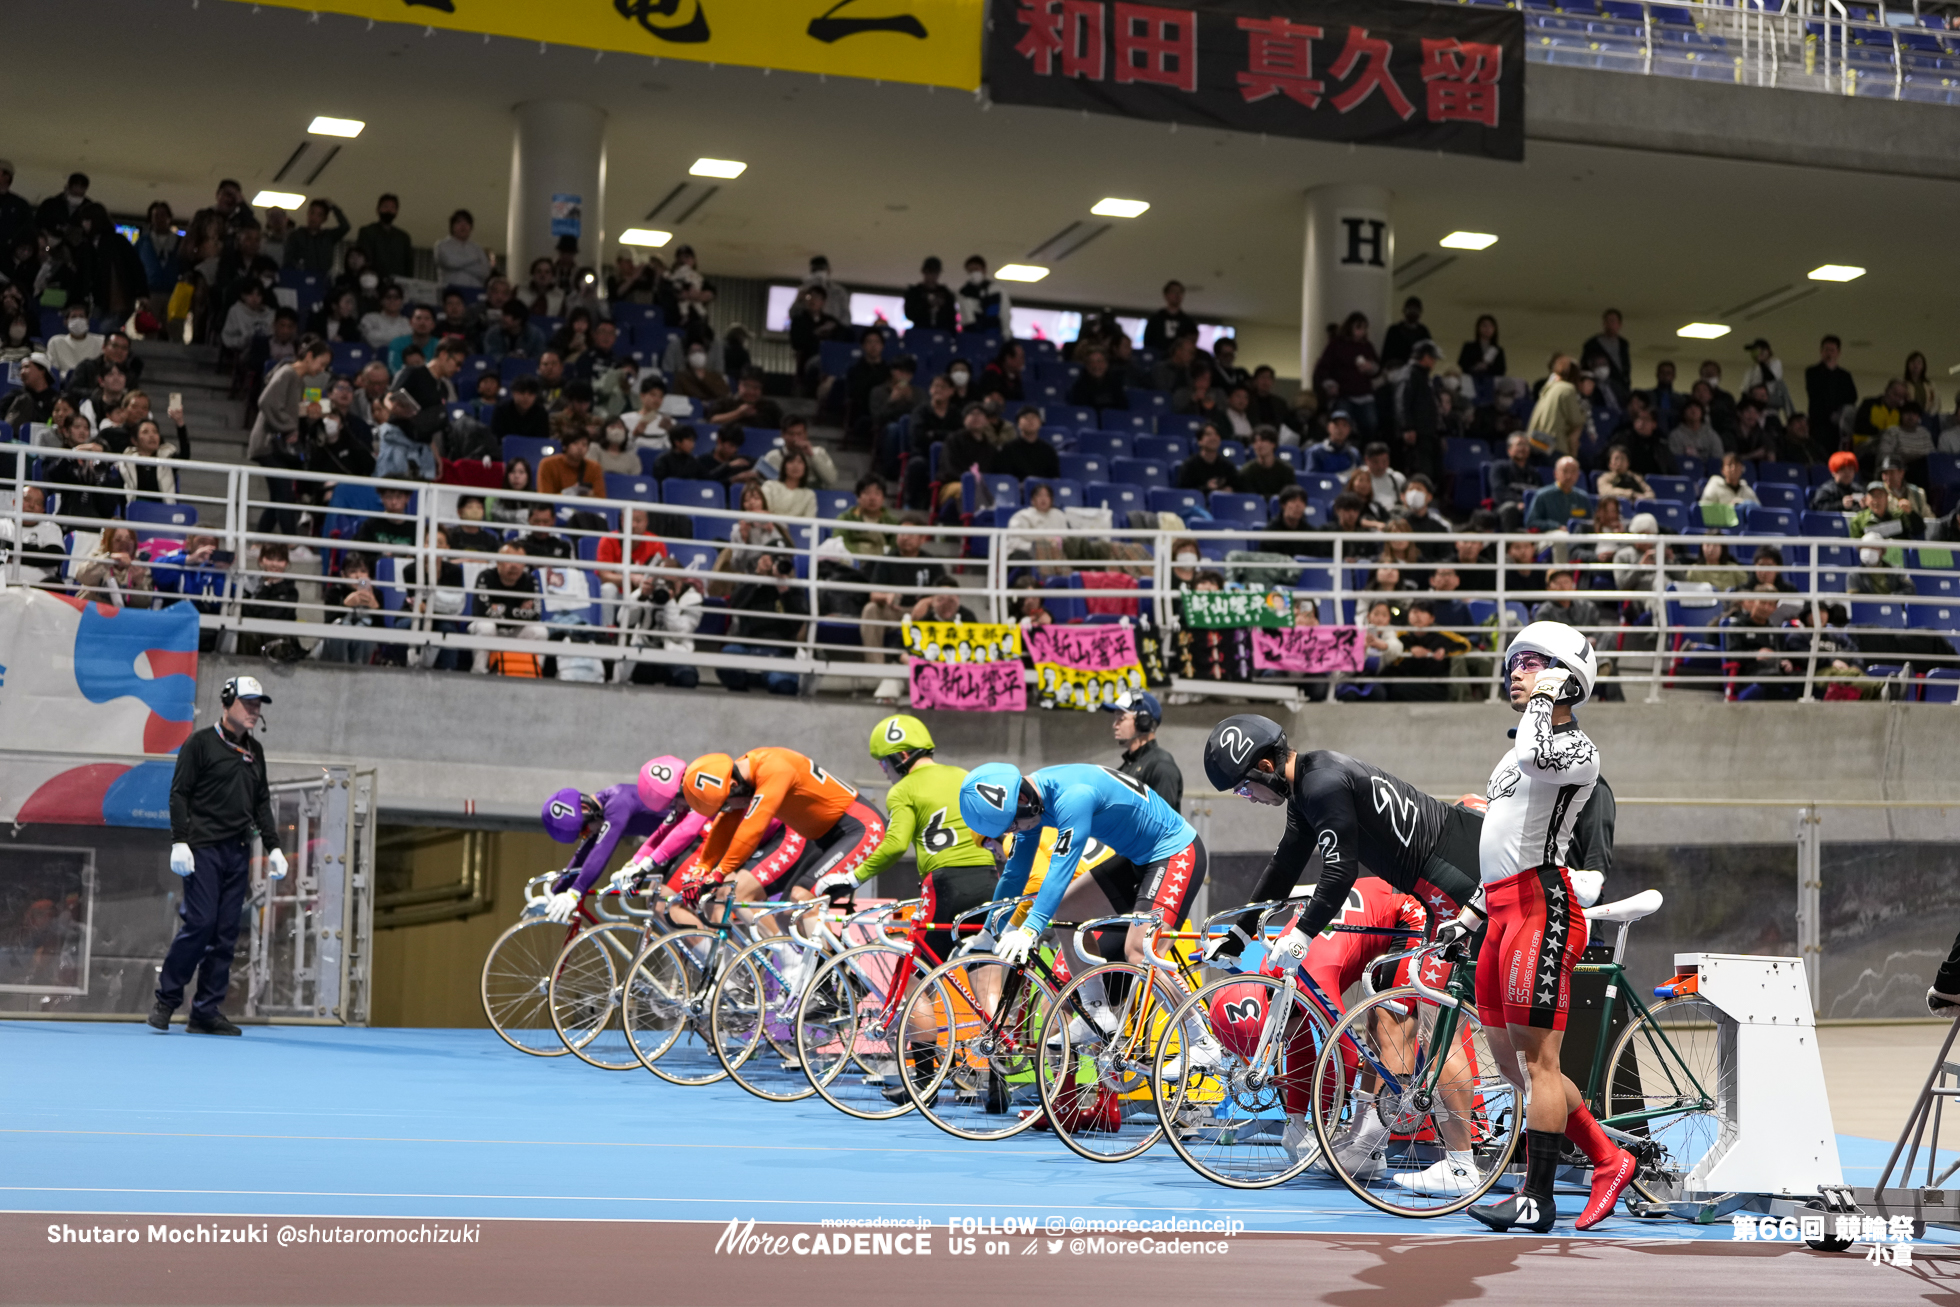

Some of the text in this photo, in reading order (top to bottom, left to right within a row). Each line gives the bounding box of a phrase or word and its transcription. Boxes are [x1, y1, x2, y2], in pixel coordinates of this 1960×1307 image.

[1015, 0, 1198, 93] 和田
[1236, 16, 1503, 128] 真久留
[1341, 217, 1386, 267] H
[1574, 637, 1590, 664] 1
[885, 718, 906, 743] 6
[1220, 726, 1254, 764] 2
[650, 764, 674, 784] 8
[695, 771, 724, 791] 7
[811, 759, 858, 796] 7
[975, 782, 1008, 811] 4
[550, 801, 576, 821] 9
[1371, 775, 1419, 847] 2
[922, 807, 958, 855] 6
[1052, 827, 1074, 857] 4
[1317, 829, 1340, 863] 2
[1526, 956, 1536, 969] KING
[1529, 947, 1537, 956] OF
[1523, 969, 1533, 988] CLASS
[1516, 987, 1530, 1004] SS
[1559, 993, 1568, 1008] SS
[1223, 996, 1262, 1024] 3
[1585, 1157, 1630, 1225] TEAM BRIDGESTONE
